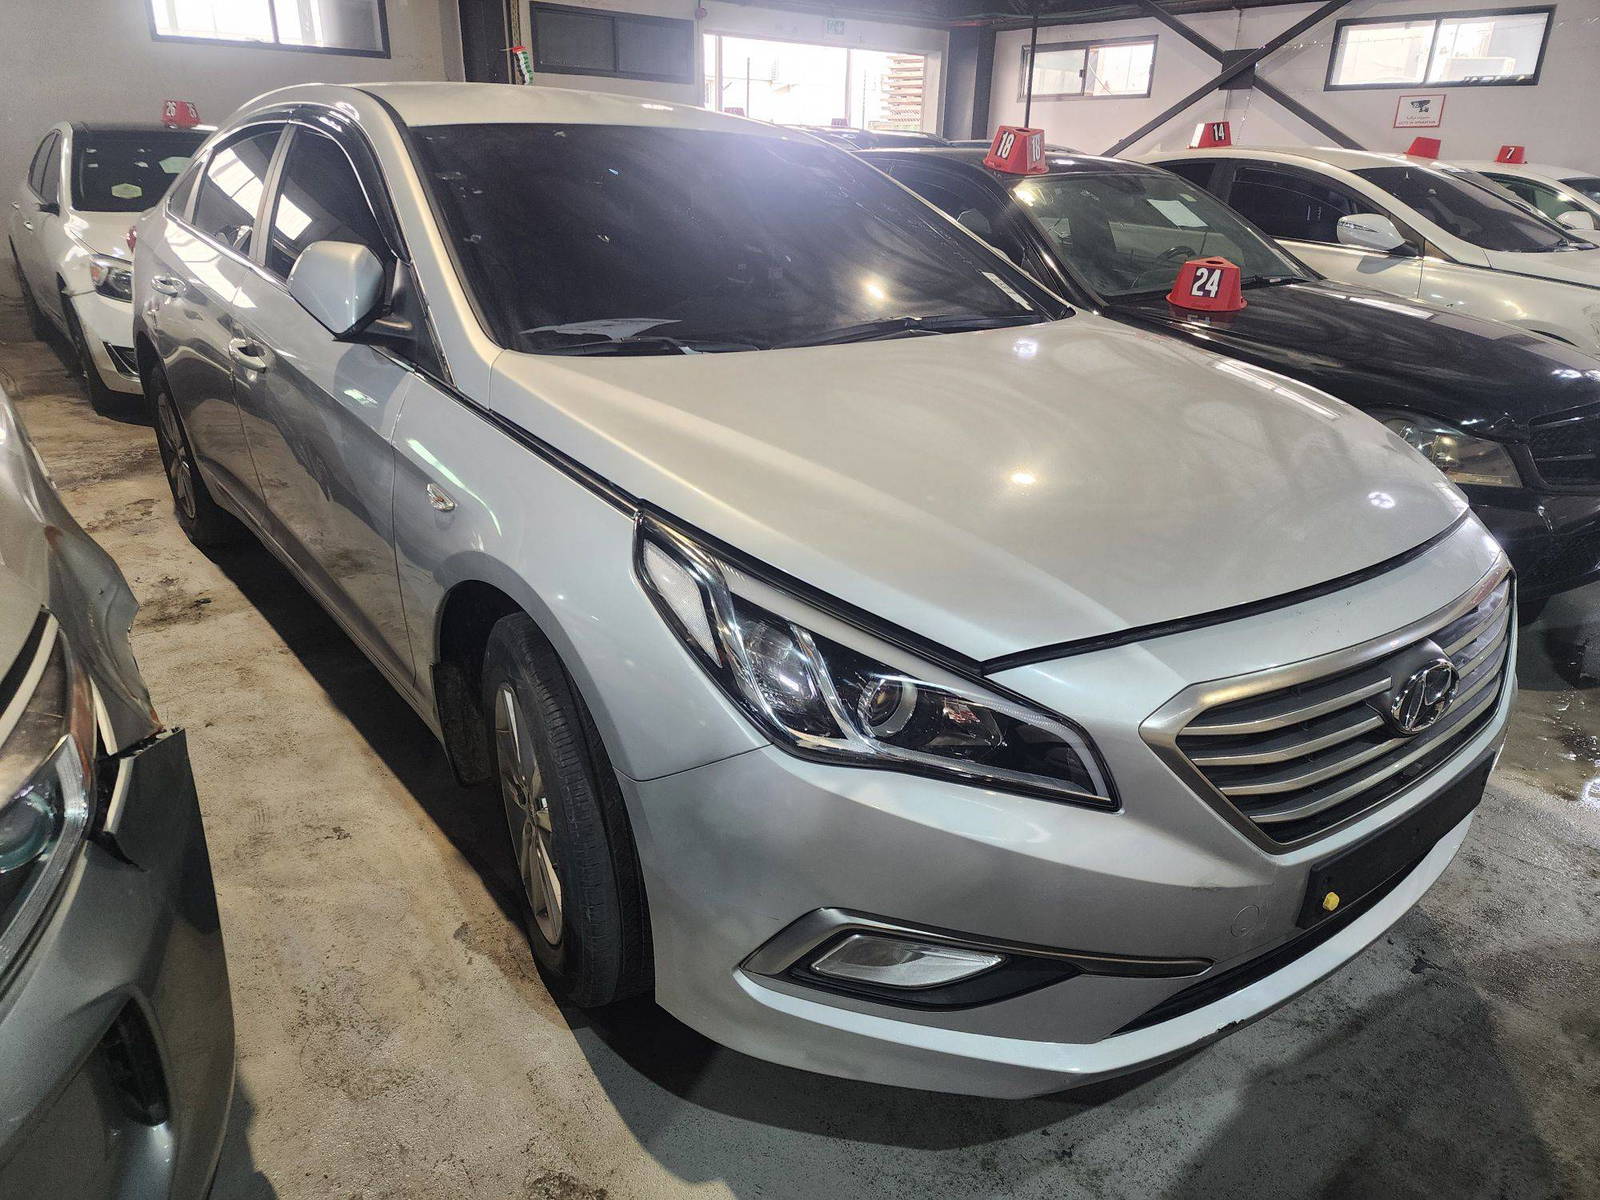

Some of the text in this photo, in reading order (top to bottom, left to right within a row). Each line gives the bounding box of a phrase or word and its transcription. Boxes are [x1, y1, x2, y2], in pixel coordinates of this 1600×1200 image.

[997, 131, 1015, 159] 18
[1213, 123, 1225, 141] 14
[1031, 135, 1041, 162] 18
[1506, 147, 1515, 159] 7
[1191, 267, 1222, 298] 24
